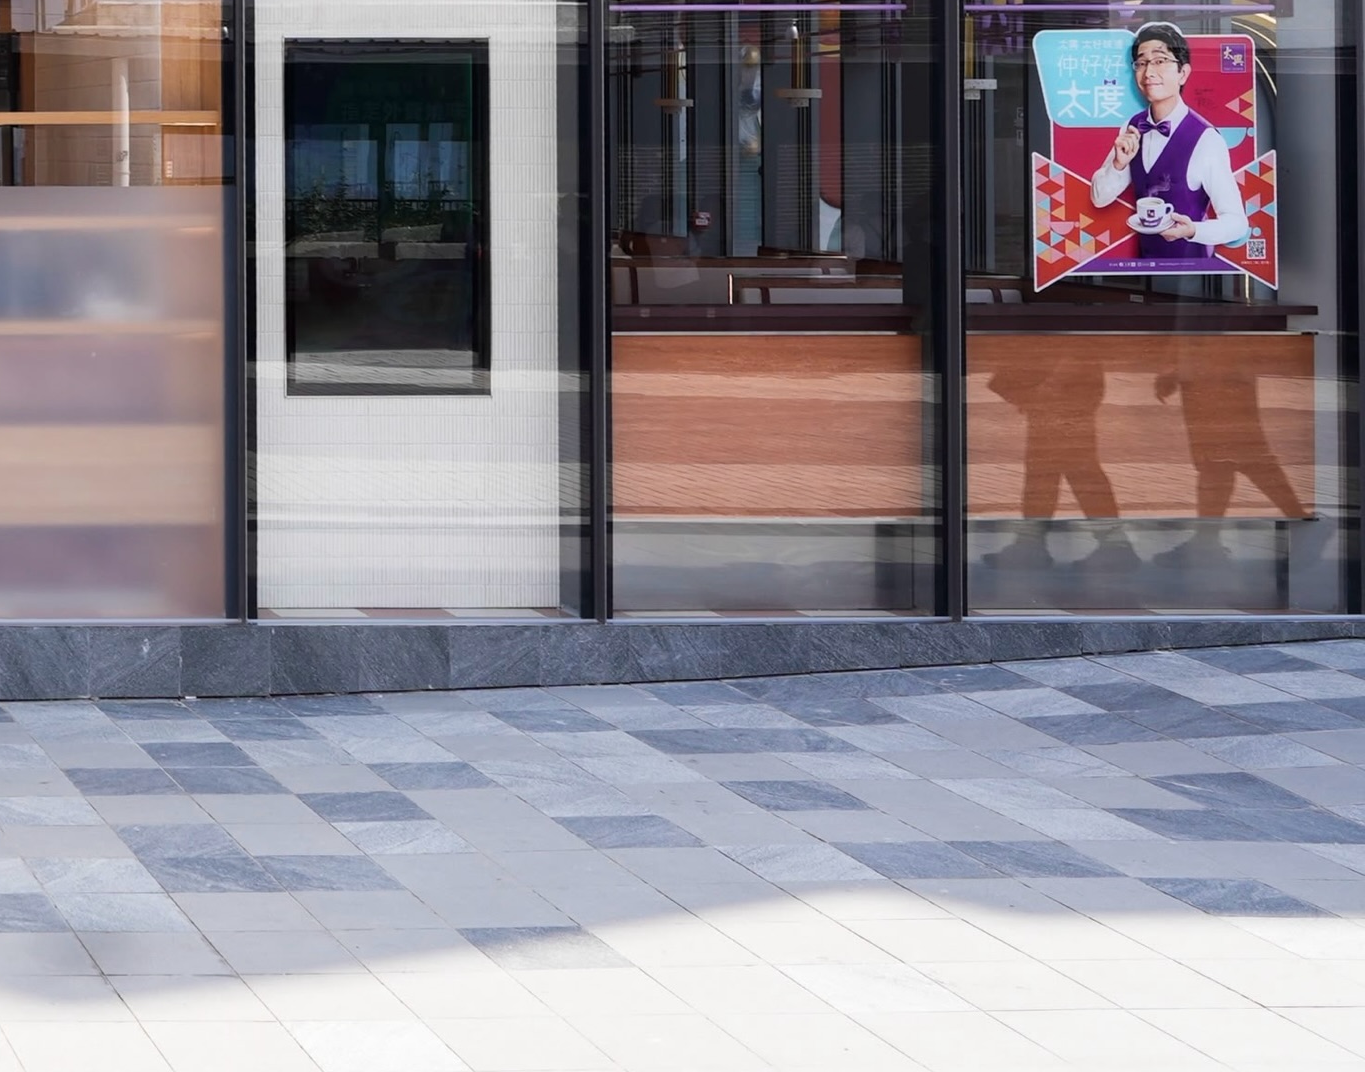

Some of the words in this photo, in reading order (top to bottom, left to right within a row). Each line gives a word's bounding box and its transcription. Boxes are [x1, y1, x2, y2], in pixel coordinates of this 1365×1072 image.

[1057, 55, 1125, 77] 仲好好
[1057, 80, 1125, 118] 太度
